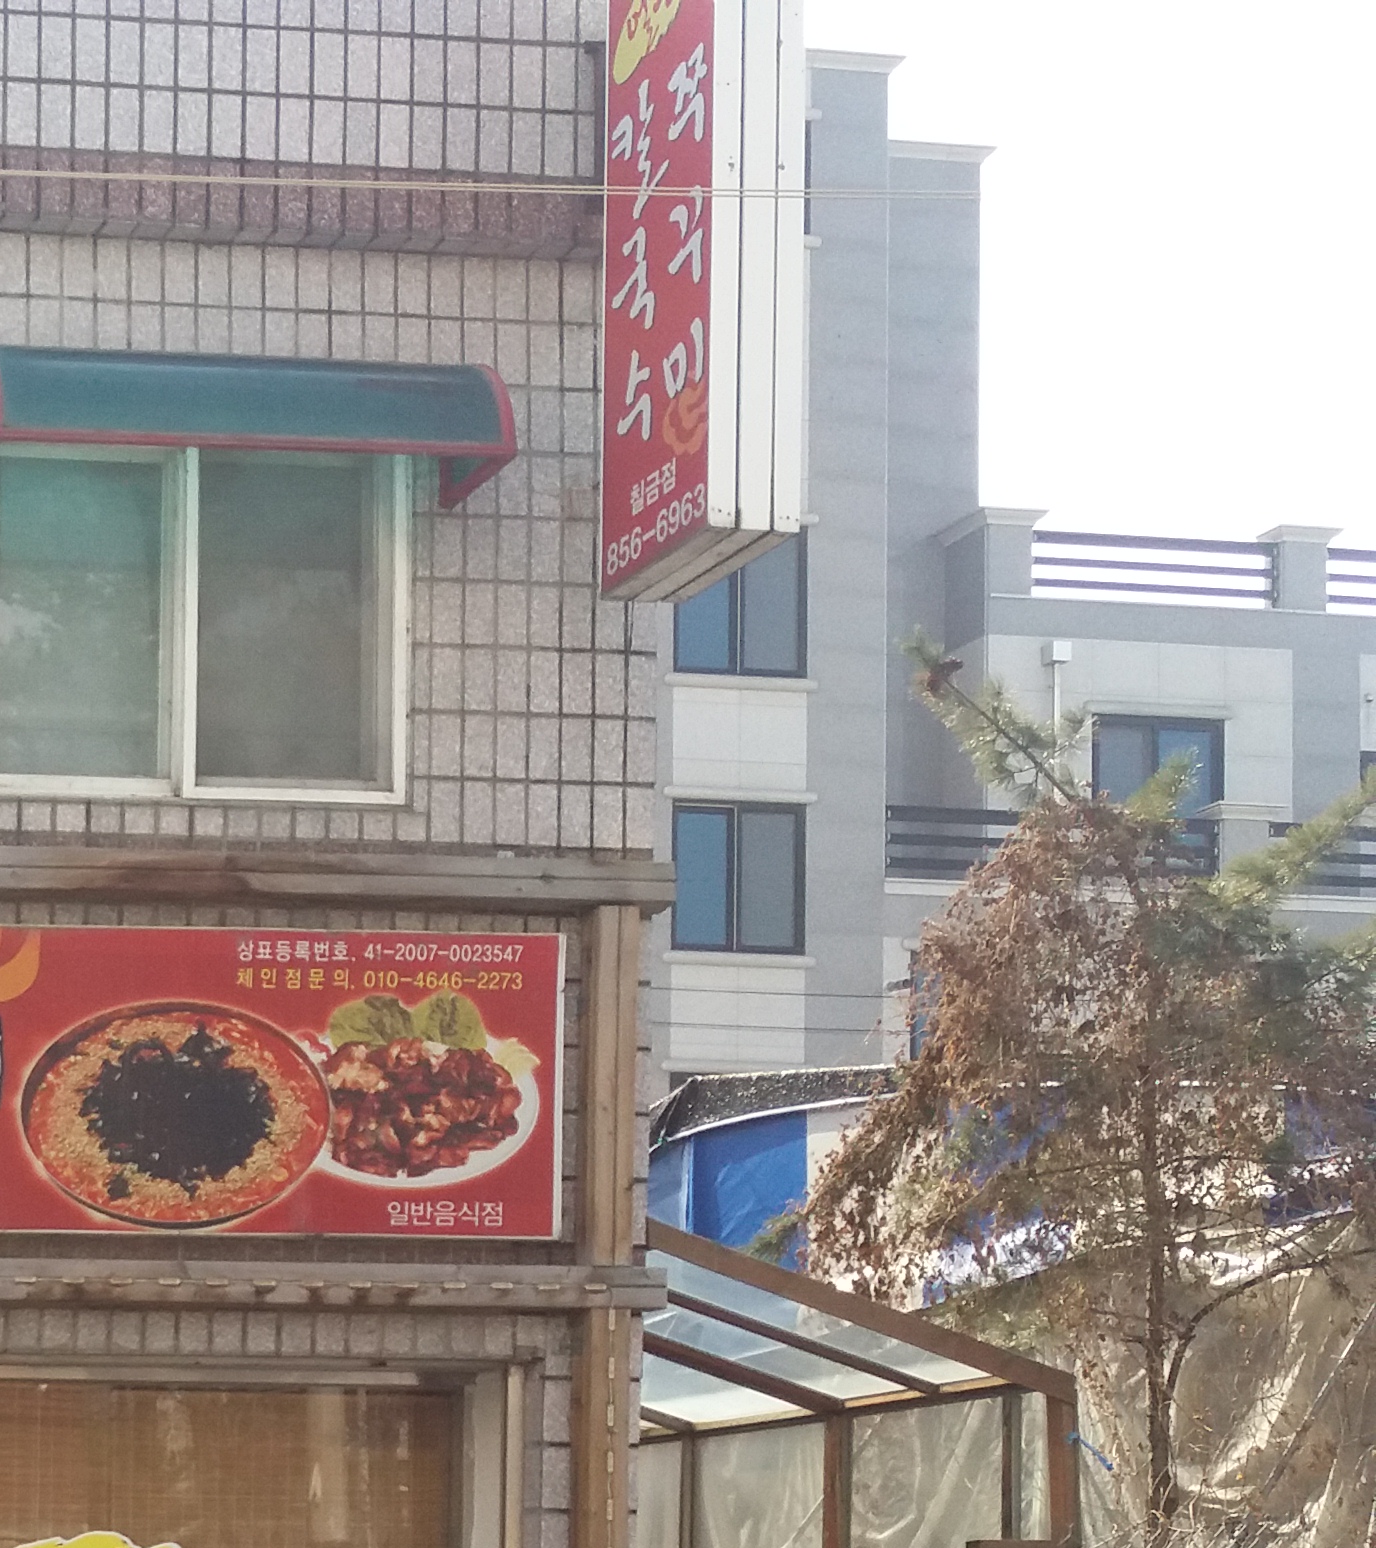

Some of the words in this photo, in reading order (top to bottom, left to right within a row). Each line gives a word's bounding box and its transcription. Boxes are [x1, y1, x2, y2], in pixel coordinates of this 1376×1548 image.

[611, 81, 668, 440] 칼국수
[630, 457, 676, 516] 칠금점
[607, 483, 705, 575] 856-6963
[364, 943, 523, 963] 41-2007-0023547
[363, 970, 523, 990] 010-4646-2273
[387, 1200, 503, 1227] 일반음식점
